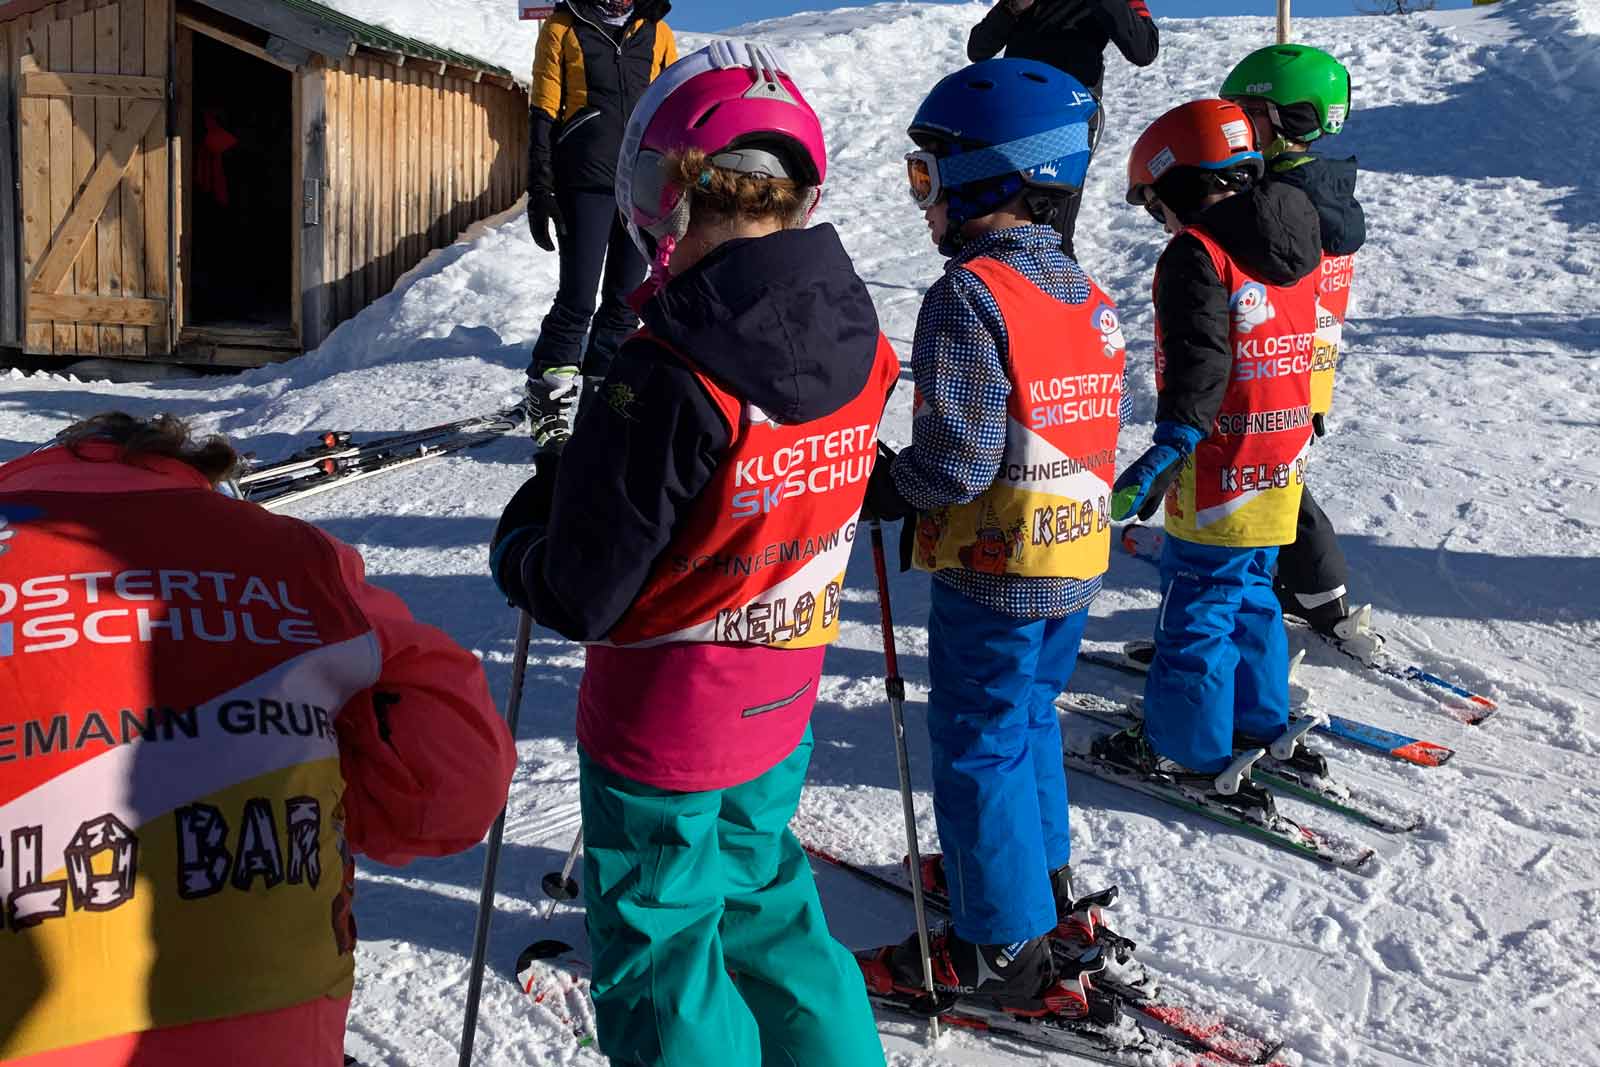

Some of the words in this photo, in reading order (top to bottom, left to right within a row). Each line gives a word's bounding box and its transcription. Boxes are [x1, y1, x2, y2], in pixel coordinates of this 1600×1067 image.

[1218, 406, 1311, 436] SCHNEEMANN
[1219, 462, 1290, 493] KELO
[1031, 499, 1094, 547] KELO
[713, 590, 817, 644] KELO
[217, 699, 337, 744] GRUP
[0, 812, 139, 933] LO
[174, 795, 322, 900] BAR
